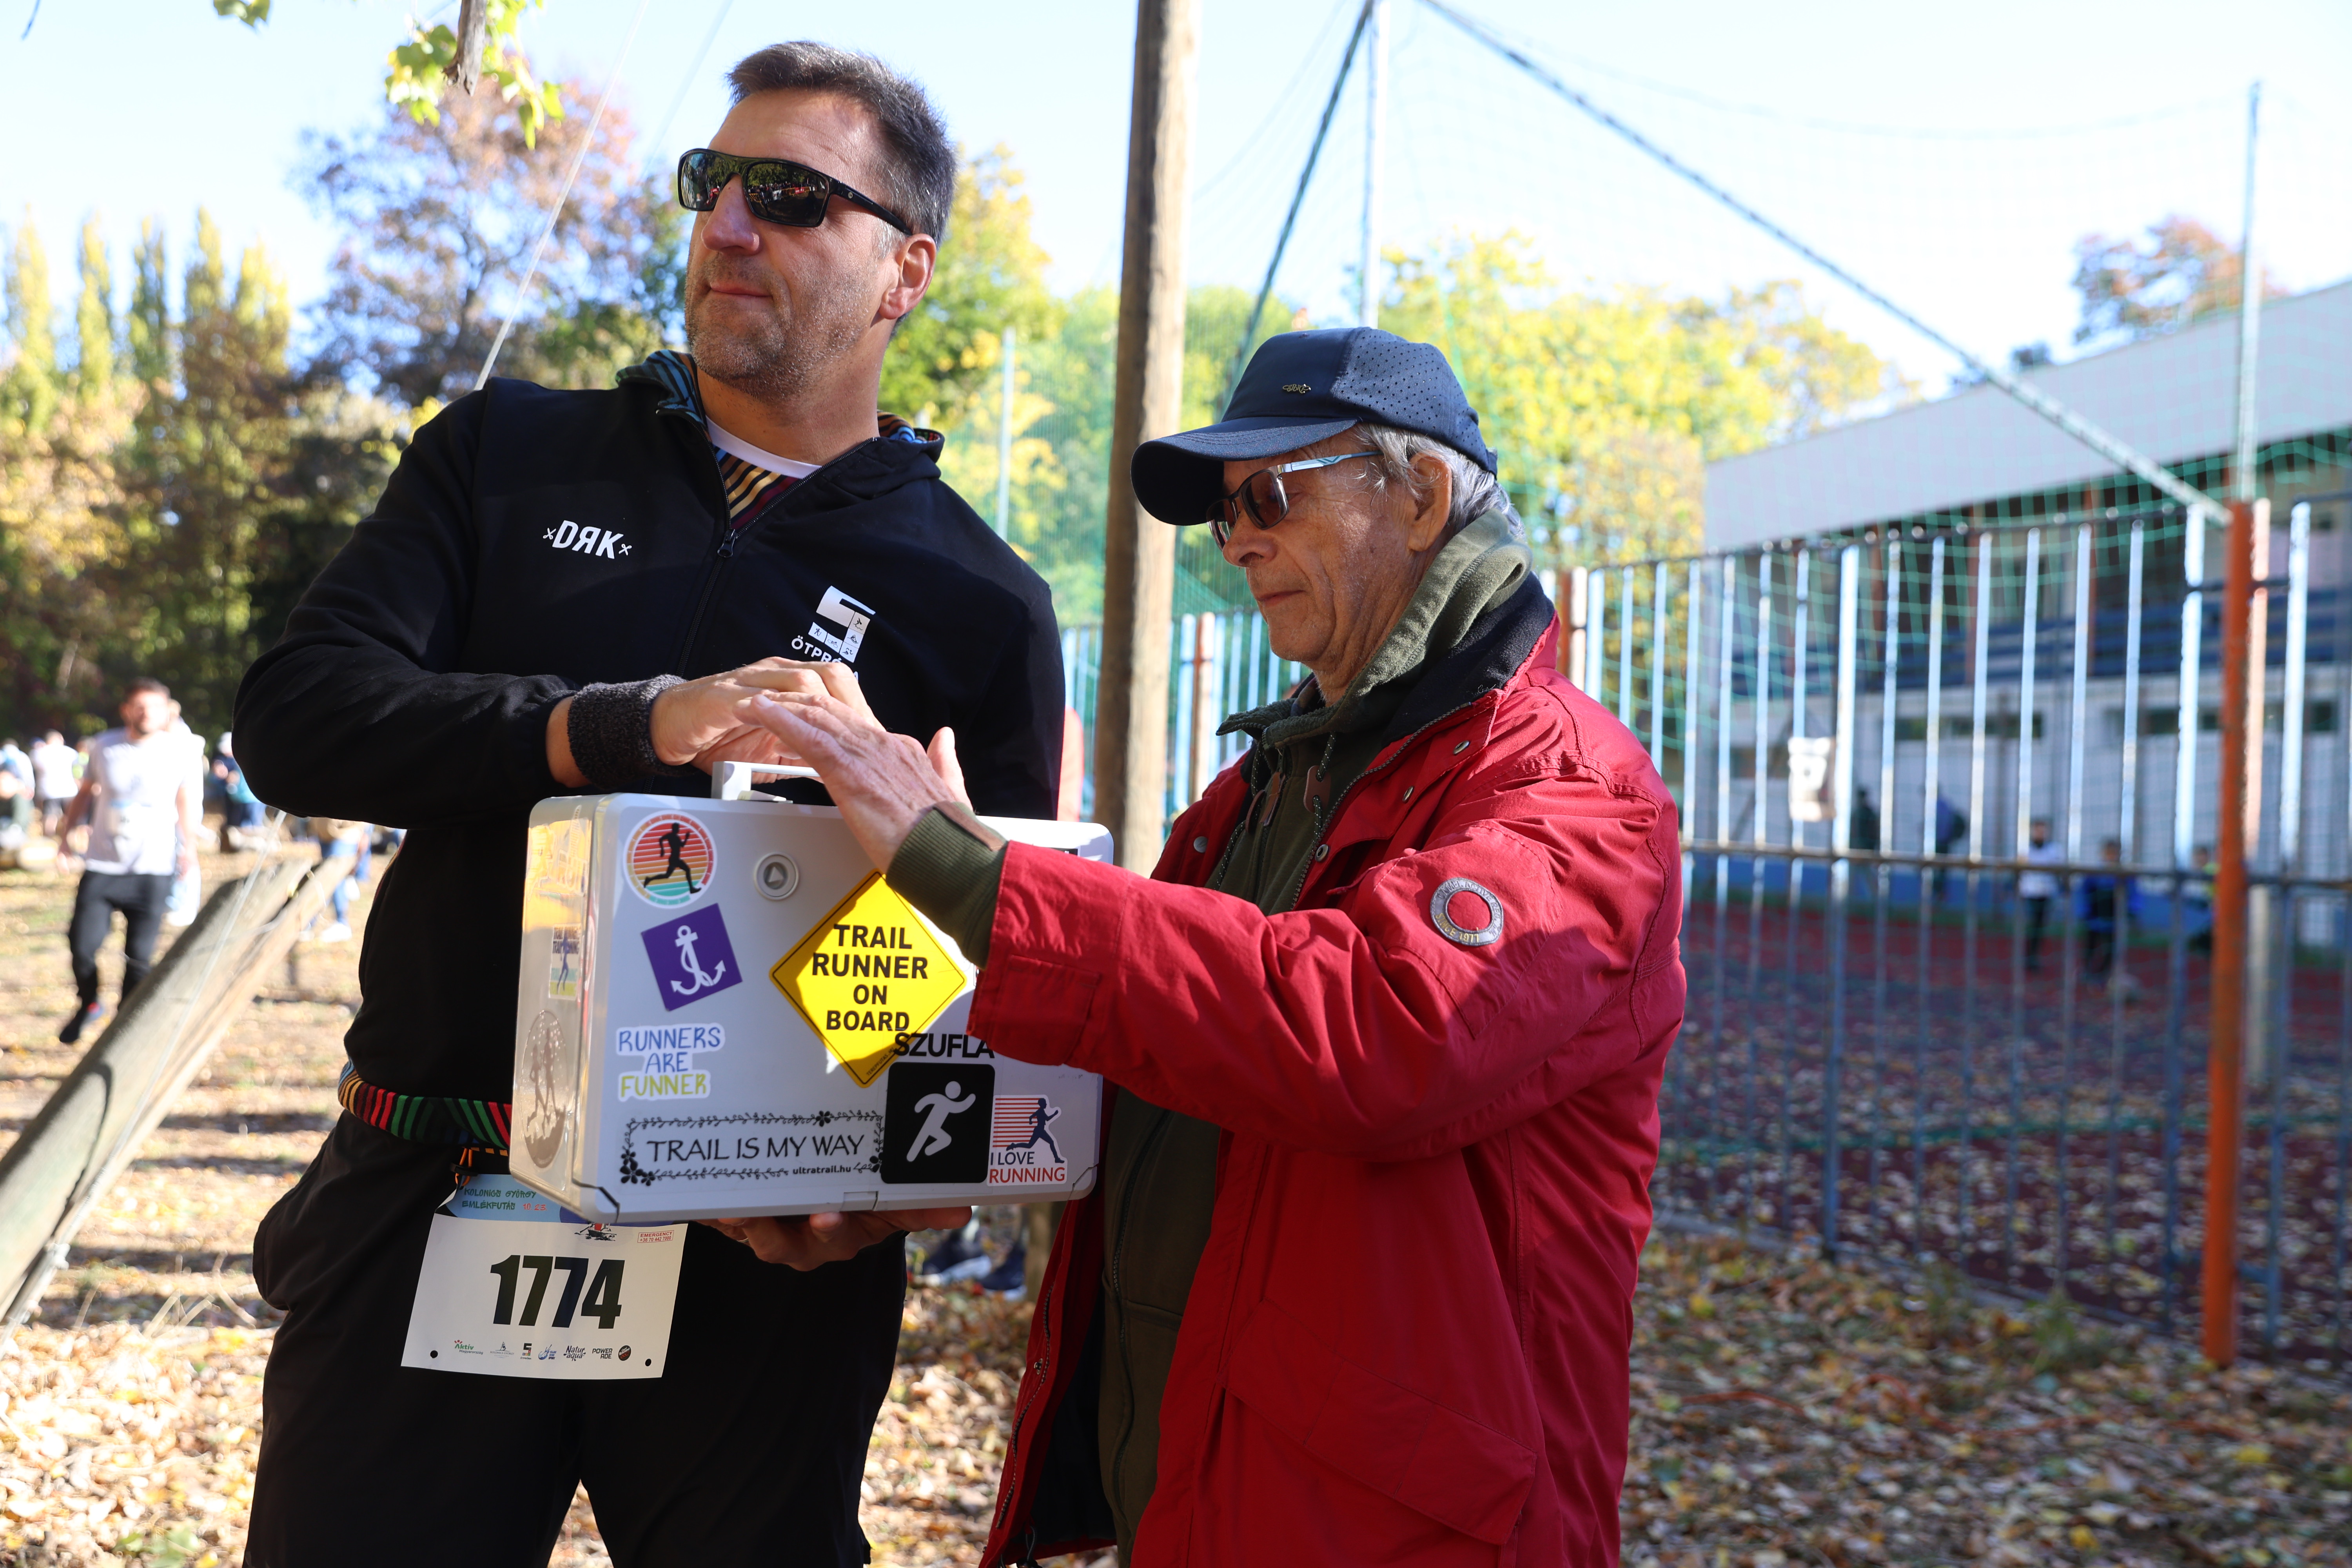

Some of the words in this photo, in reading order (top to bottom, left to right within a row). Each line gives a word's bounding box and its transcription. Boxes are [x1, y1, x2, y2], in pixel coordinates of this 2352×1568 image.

[1465, 882, 1494, 900] ACTIVE
[833, 924, 913, 950] TRAIL
[1435, 913, 1456, 936] SINCE
[1459, 932, 1479, 943] 1977
[812, 952, 928, 979] RUNNER
[853, 984, 887, 1005] ON
[826, 1010, 910, 1031] BOARD
[619, 1027, 720, 1052] RUNNERS
[894, 1032, 995, 1059] SZUFLA
[645, 1052, 688, 1074] ARE
[621, 1073, 706, 1097] FUNNER
[647, 1138, 730, 1162] TRAIL
[736, 1137, 760, 1159] IS
[767, 1136, 807, 1158] MY
[812, 1134, 865, 1156] WAY
[990, 1152, 994, 1165] I
[998, 1151, 1035, 1165] LOVE
[793, 1165, 851, 1175] ultratrail.hu
[989, 1167, 1065, 1183] RUNNING
[505, 1189, 537, 1198] GYÖRGY
[462, 1200, 516, 1210] EMLÉKFUTÁS
[490, 1254, 625, 1329] 1774
[566, 1352, 583, 1361] aqua
